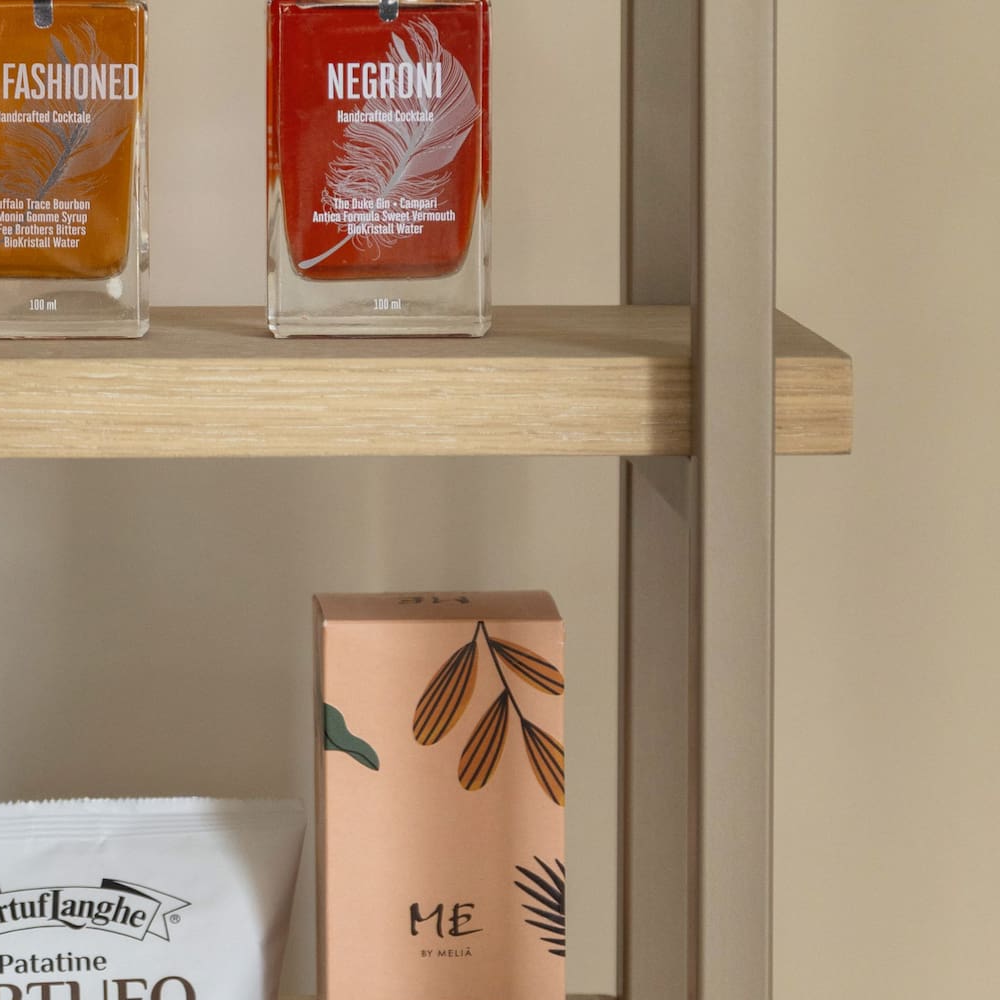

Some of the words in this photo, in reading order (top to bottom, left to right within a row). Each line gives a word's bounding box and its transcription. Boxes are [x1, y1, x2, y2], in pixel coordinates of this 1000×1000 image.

[3, 63, 139, 100] FASHIONED
[327, 62, 442, 100] NEGRONI
[52, 110, 91, 123] Cocktale
[337, 110, 393, 123] Handcrafted
[26, 198, 50, 210] Trace
[53, 198, 90, 210] Bourbon
[334, 198, 349, 209] The
[352, 198, 373, 209] Duke
[376, 198, 390, 209] Gin
[400, 198, 437, 211] Campari
[26, 211, 59, 222] Gomme
[61, 211, 87, 225] Syrup
[312, 211, 340, 222] Antica
[343, 211, 380, 222] Formula
[382, 211, 409, 222] Sweet
[412, 210, 456, 222] Vermouth
[15, 223, 54, 235] Brothers
[56, 223, 87, 235] Bitters
[347, 223, 395, 235] BioKristall
[397, 223, 424, 235] Water
[4, 236, 51, 248] BioKristall
[53, 236, 80, 248] Water
[30, 299, 45, 311] 100
[46, 299, 57, 311] ml
[374, 298, 389, 310] 100
[391, 298, 401, 310] ml
[409, 902, 484, 938] ME
[420, 949, 433, 958] BY
